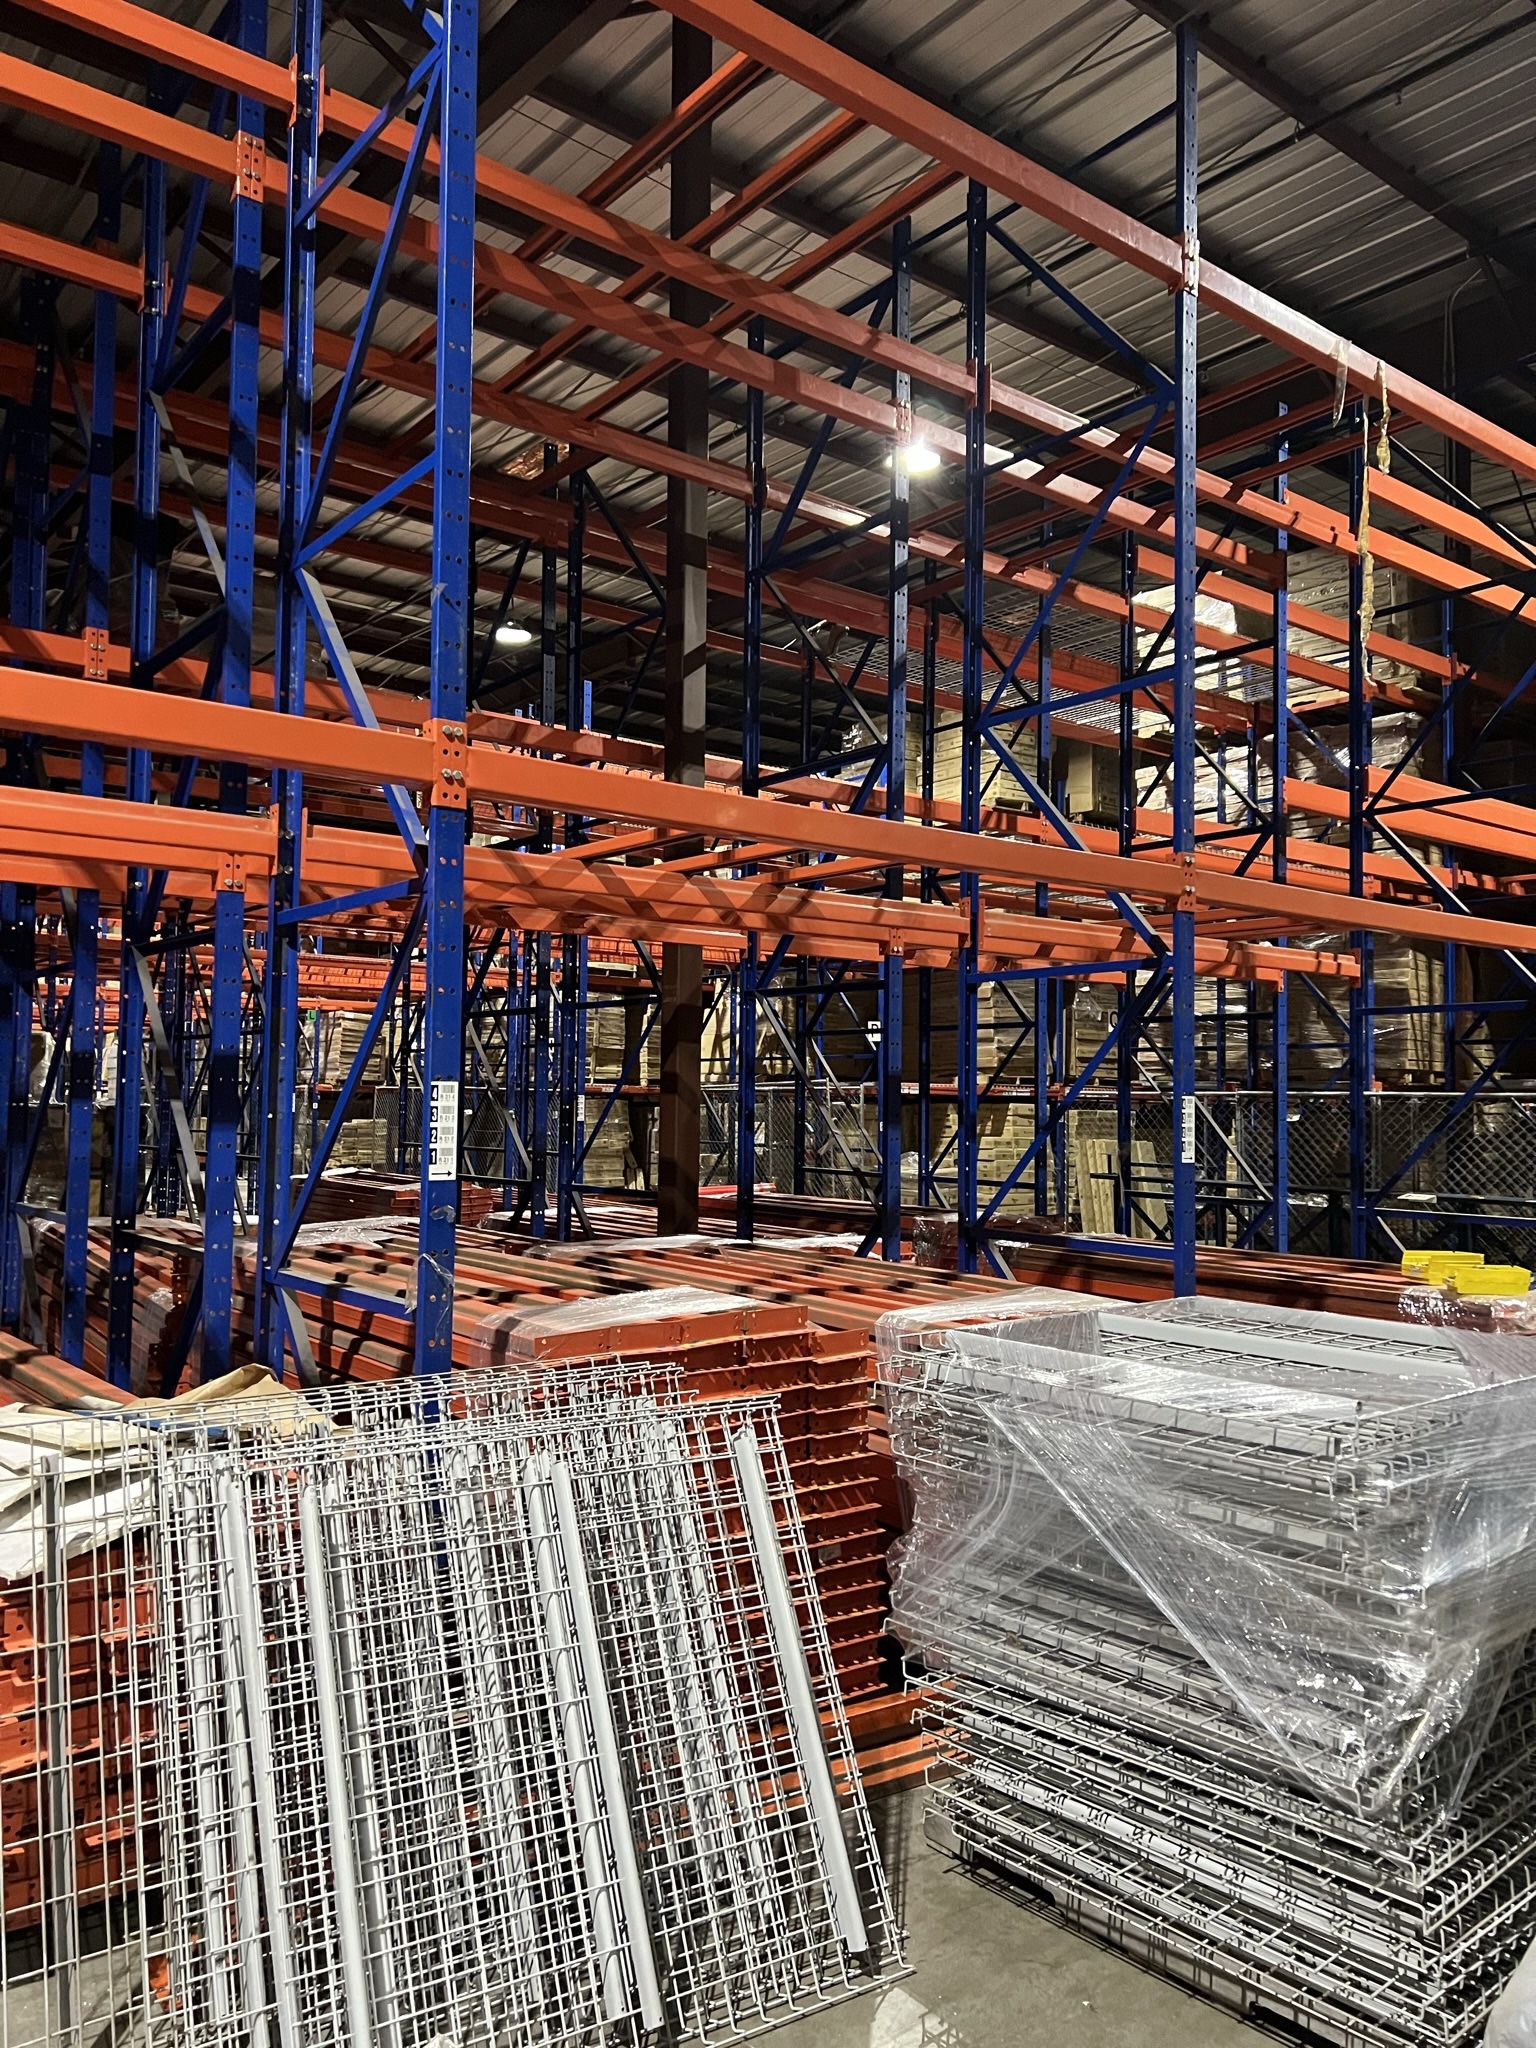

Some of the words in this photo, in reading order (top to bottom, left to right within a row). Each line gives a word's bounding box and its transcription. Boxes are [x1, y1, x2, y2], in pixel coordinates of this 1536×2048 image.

[432, 1087, 438, 1100] 4
[431, 1107, 437, 1121] 3
[431, 1129, 437, 1142] 2
[430, 1150, 436, 1163] 1
